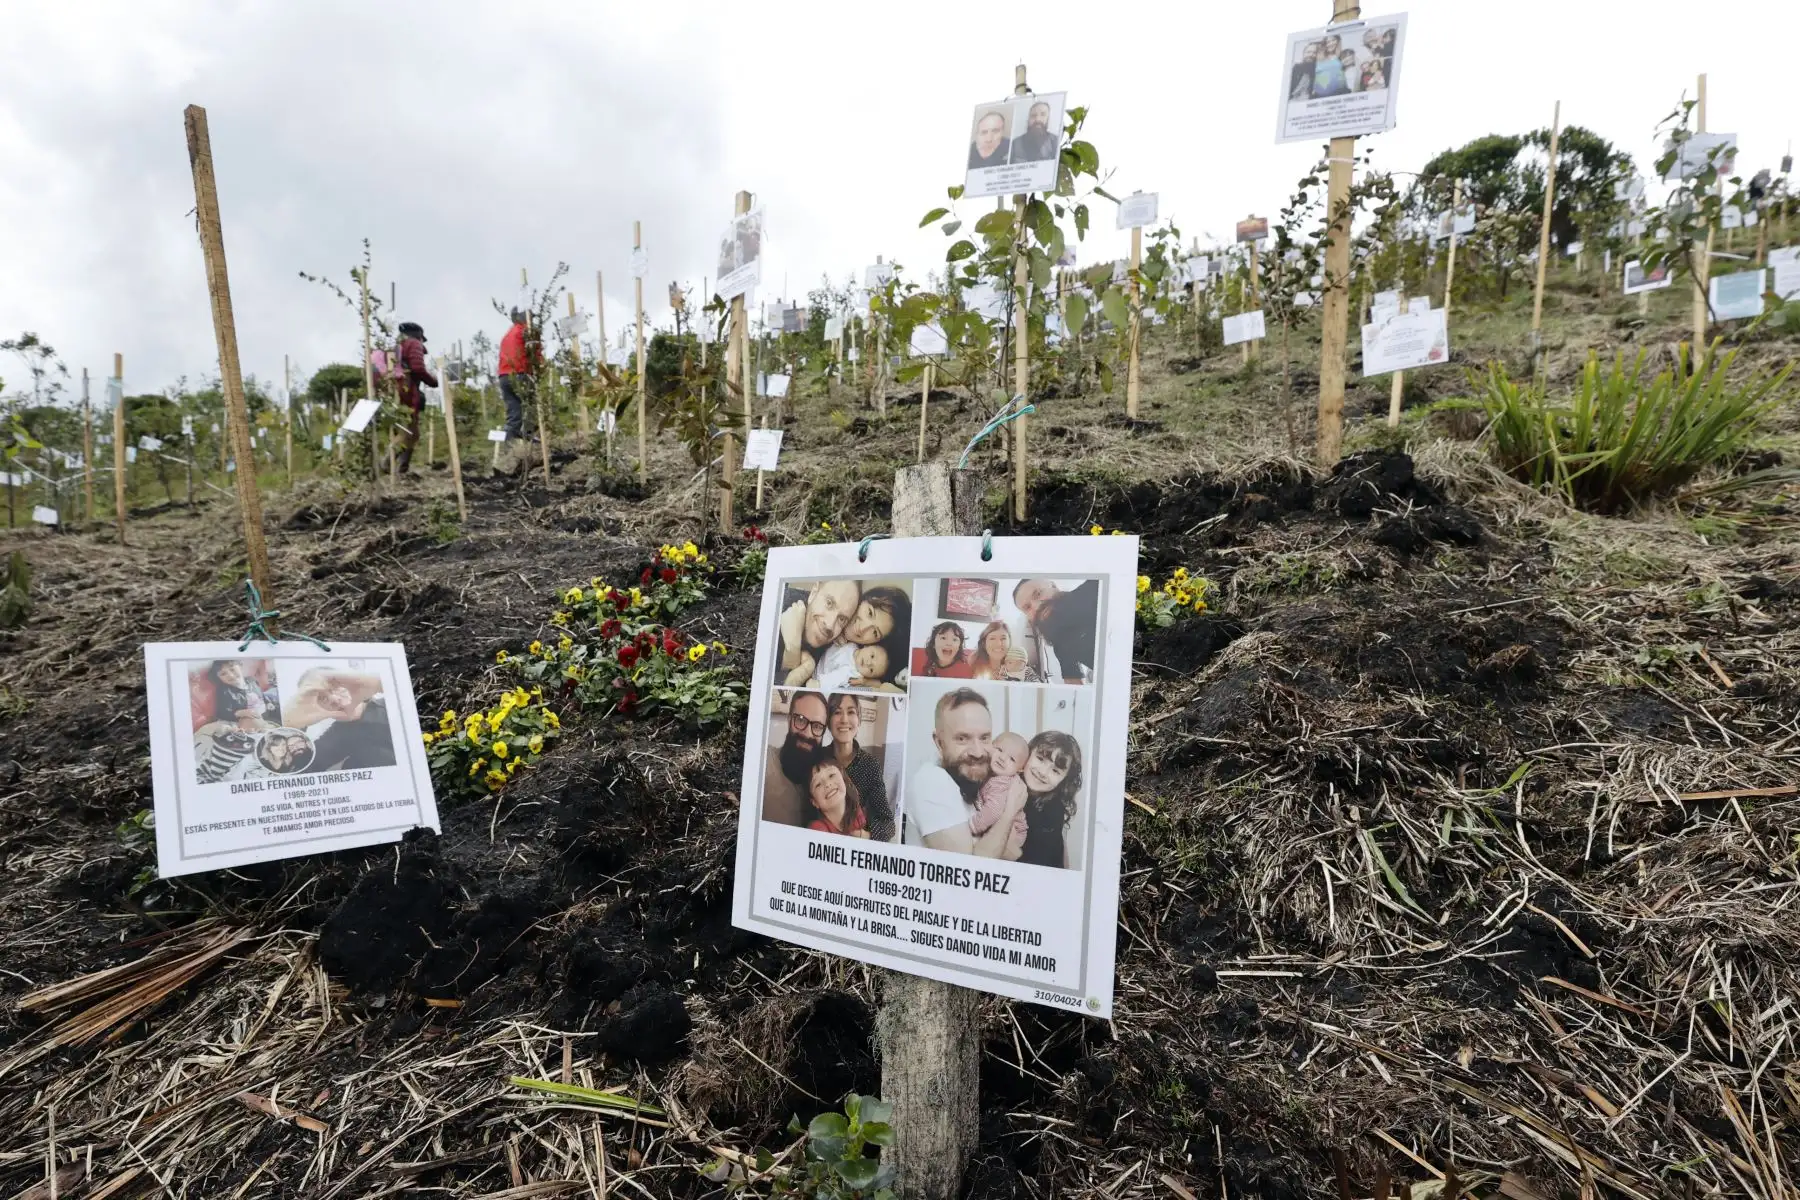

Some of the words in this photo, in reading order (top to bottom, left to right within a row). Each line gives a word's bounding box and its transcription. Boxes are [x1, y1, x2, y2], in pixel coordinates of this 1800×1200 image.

[231, 782, 265, 794] DANIEL
[268, 777, 315, 790] FERNANDO
[318, 774, 350, 784] TORRES
[352, 771, 373, 780] PAEZ
[210, 820, 246, 830] PRESENTE
[258, 814, 293, 824] NUESTROS
[295, 810, 321, 819] LATIDOS
[351, 804, 375, 812] LATIDOS
[261, 804, 275, 812] DAS
[296, 800, 320, 808] NUTRES
[273, 823, 302, 833] AMAMOS
[304, 821, 322, 829] AMOR
[808, 842, 847, 865] DANIEL
[851, 850, 915, 878] FERNANDO
[919, 862, 970, 888] TORRES
[974, 871, 1010, 894] PAEZ
[869, 878, 932, 904] (1969-2021)
[782, 880, 796, 895] QUE
[798, 884, 822, 901] DESDE
[824, 890, 844, 906] AQUÍ
[845, 895, 891, 918] DISFRUTES
[894, 905, 910, 920] DEL
[913, 909, 950, 928] PAISAJE
[952, 916, 958, 930] Y
[961, 918, 974, 934] DE
[977, 922, 988, 936] LA
[992, 924, 1041, 946] LIBERTAD
[770, 897, 784, 912] QUE
[786, 901, 795, 914] DA
[798, 904, 807, 917] LA
[810, 907, 848, 927] MONTAÑA
[851, 916, 856, 929] Y
[858, 918, 868, 932] LA
[911, 930, 943, 949] SIGUES
[946, 937, 980, 956] DANDO
[983, 945, 1006, 962] VIDA
[1009, 950, 1021, 965] MI
[1024, 954, 1056, 972] AMOR
[1034, 990, 1082, 1007] 310/04024
